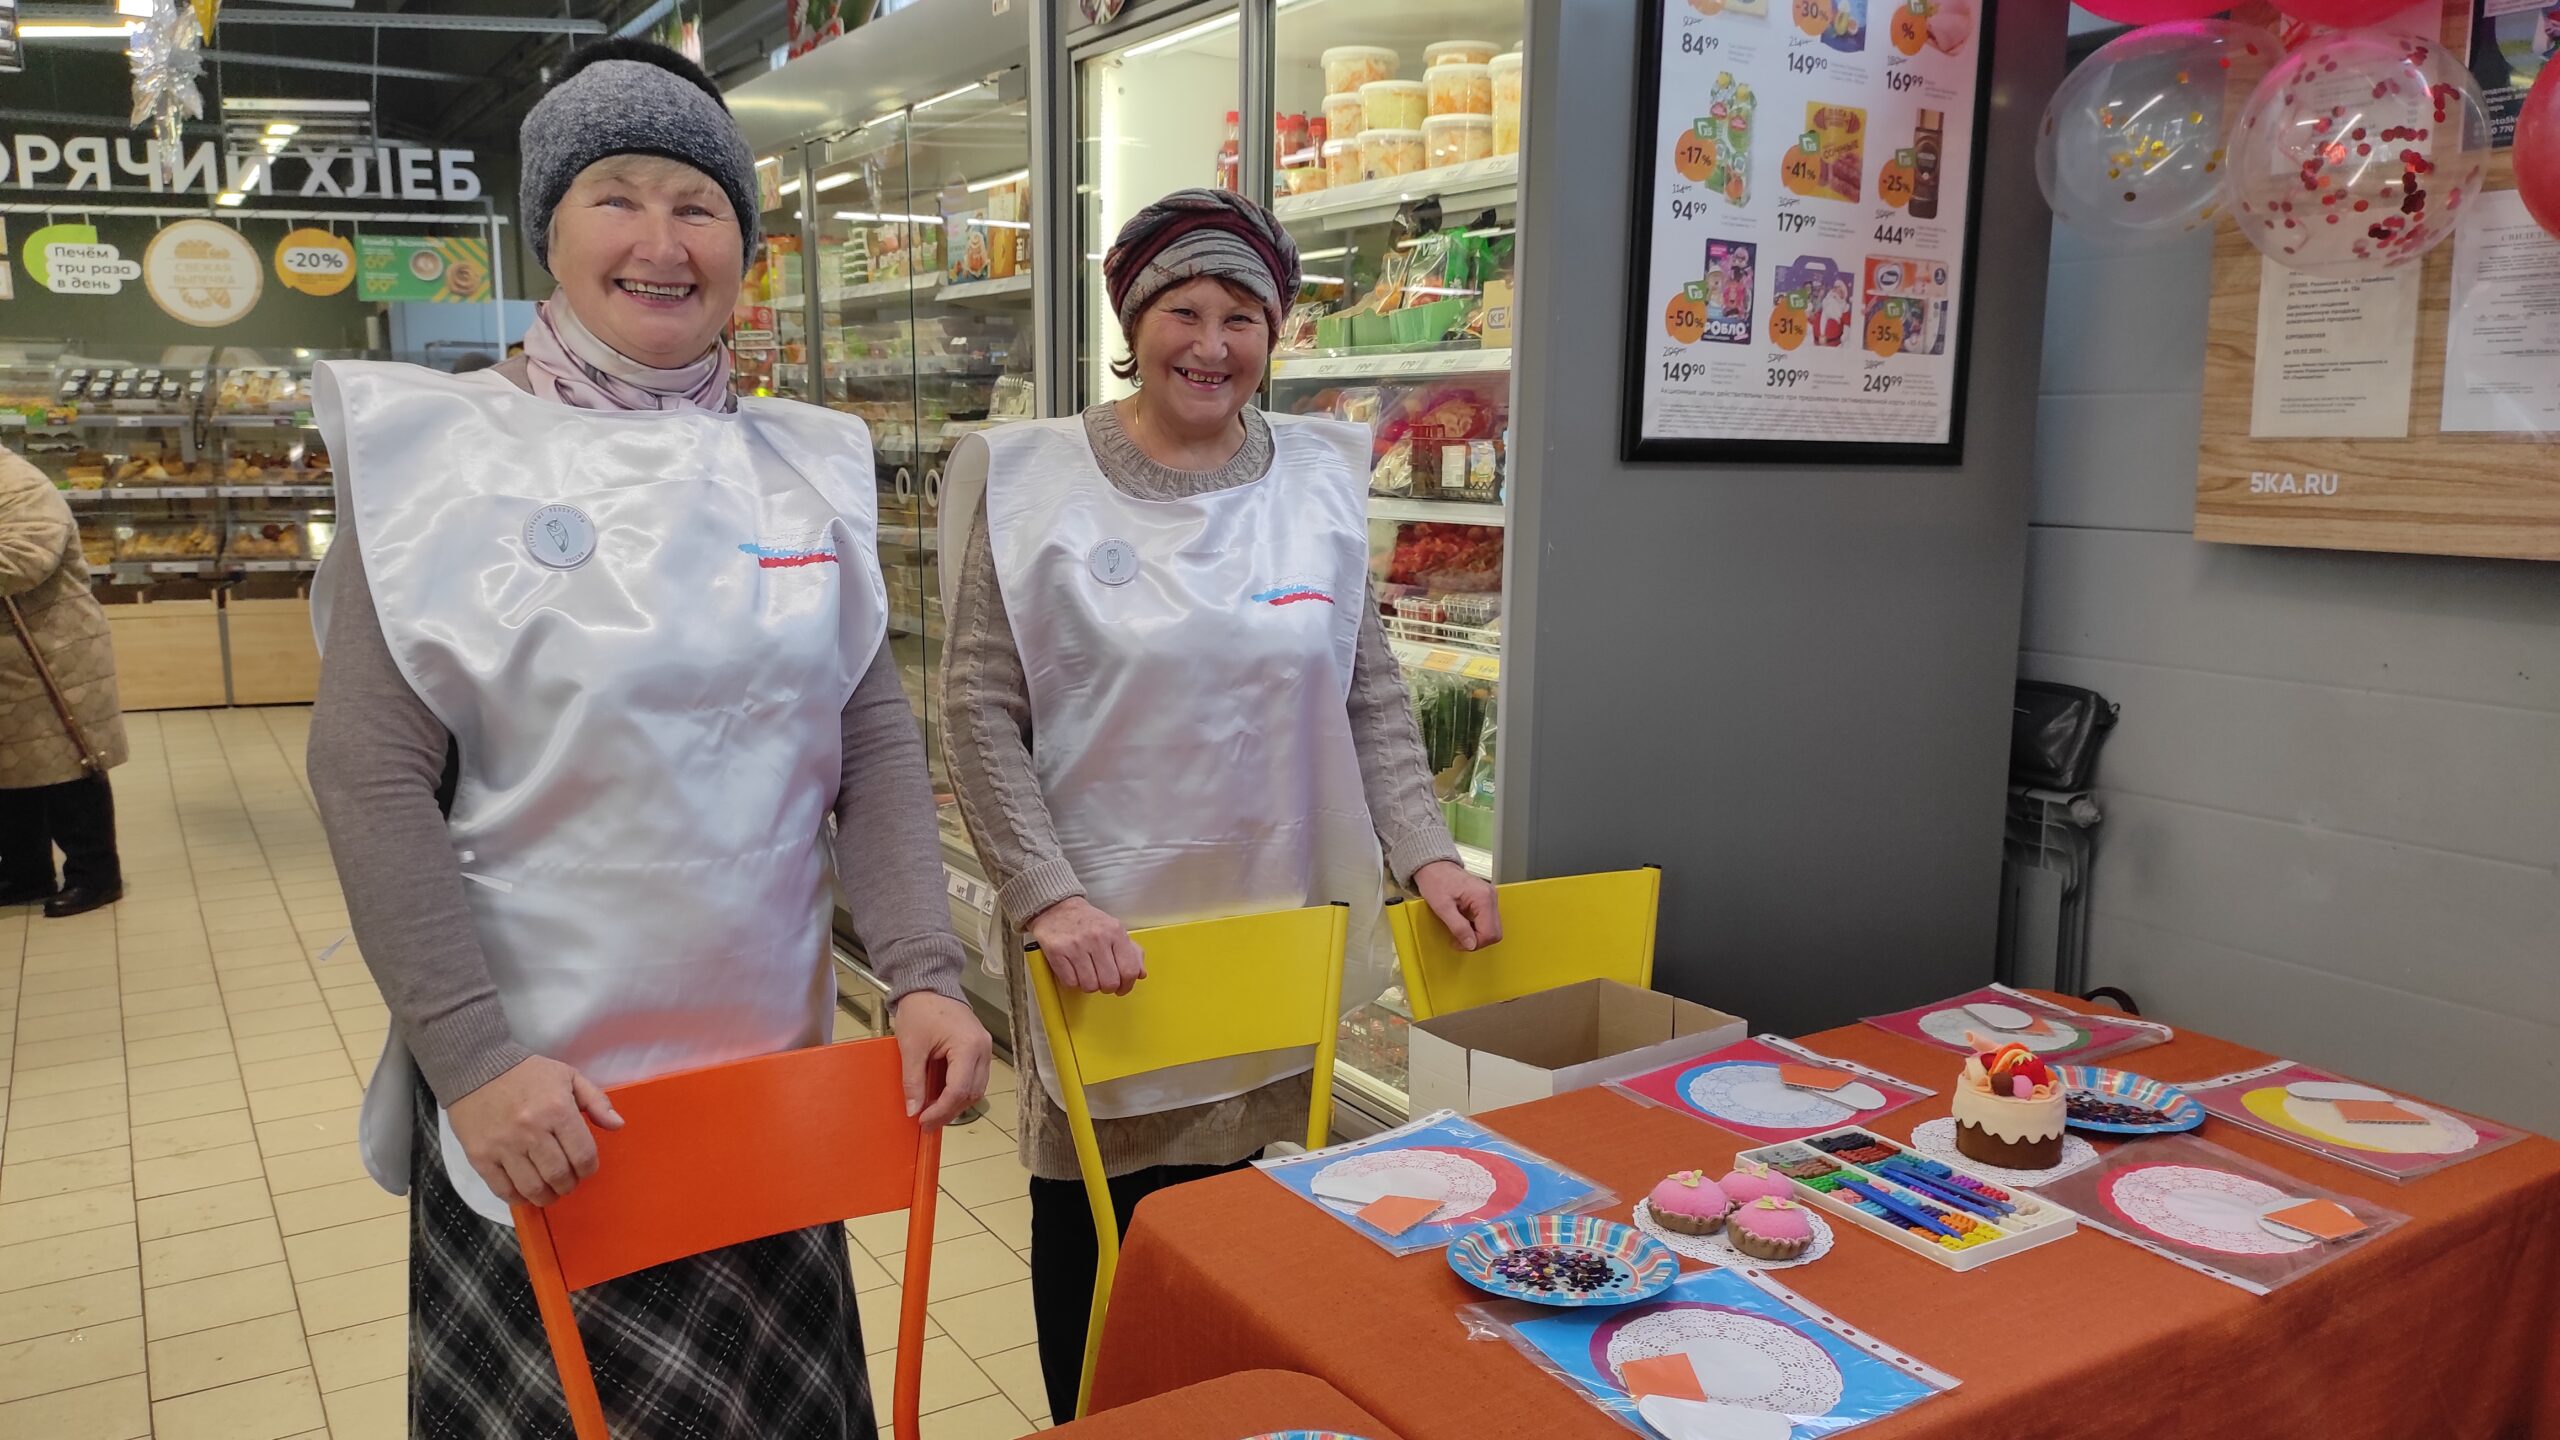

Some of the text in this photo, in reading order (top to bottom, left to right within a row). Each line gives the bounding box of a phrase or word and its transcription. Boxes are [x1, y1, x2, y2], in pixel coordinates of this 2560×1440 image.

[1680, 146, 1712, 167] -17%
[0, 134, 481, 201] РЯЧИЙ ХЛЕБ
[1786, 161, 1816, 180] -41%
[1883, 174, 1911, 193] -25%
[54, 247, 109, 259] Печём
[287, 252, 344, 269] -20%
[56, 263, 131, 275] три раза
[57, 276, 111, 290] в день
[1668, 310, 1705, 328] -50%
[1774, 318, 1804, 336] -31%
[1871, 325, 1900, 343] -35%
[2250, 471, 2338, 496] 5KA.RU
